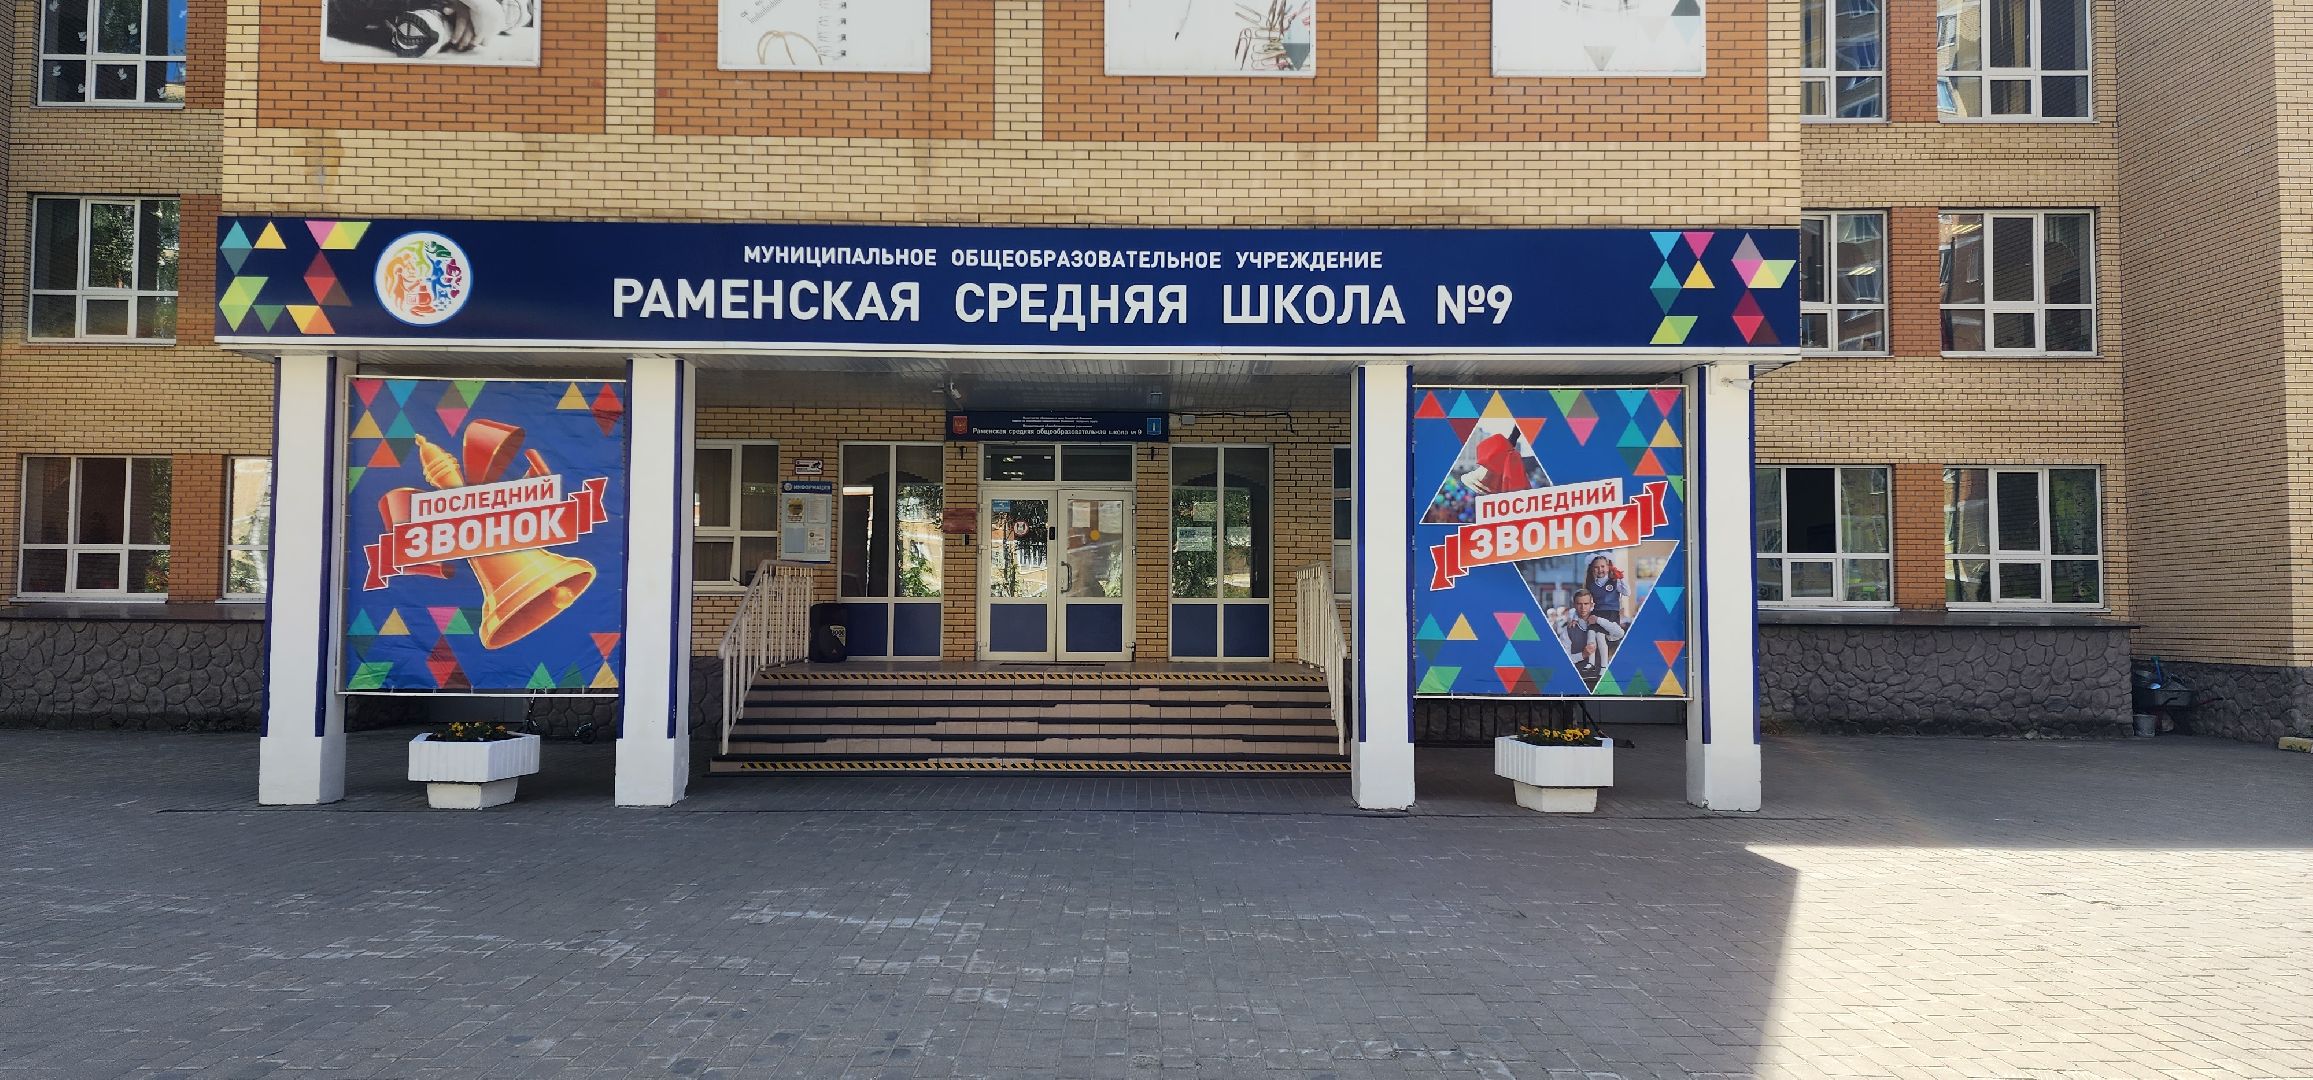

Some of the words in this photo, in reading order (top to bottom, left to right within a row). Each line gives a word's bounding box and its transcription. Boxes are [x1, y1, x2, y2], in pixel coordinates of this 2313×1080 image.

[744, 245, 937, 268] МУНИЦИПАЛЬНОЕ
[951, 248, 1222, 271] ОБЩЕОБРАЗОВАТЕЛЬНОЕ
[1235, 251, 1383, 272] УЧРЕЖДЕНИЕ
[613, 278, 920, 322] РАМЕНСКАЯ
[955, 282, 1187, 332] СРЕДНЯЯ
[1223, 284, 1406, 325] ШКОЛА
[1437, 284, 1513, 325] №9
[972, 427, 1007, 436] Раменская
[418, 478, 554, 517] ПОСЛЕДНИЙ
[1482, 481, 1616, 519] ПОСЛЕДНИЙ
[404, 507, 567, 558] ЗВОНОК
[1469, 509, 1629, 560] ЗВОНОК
